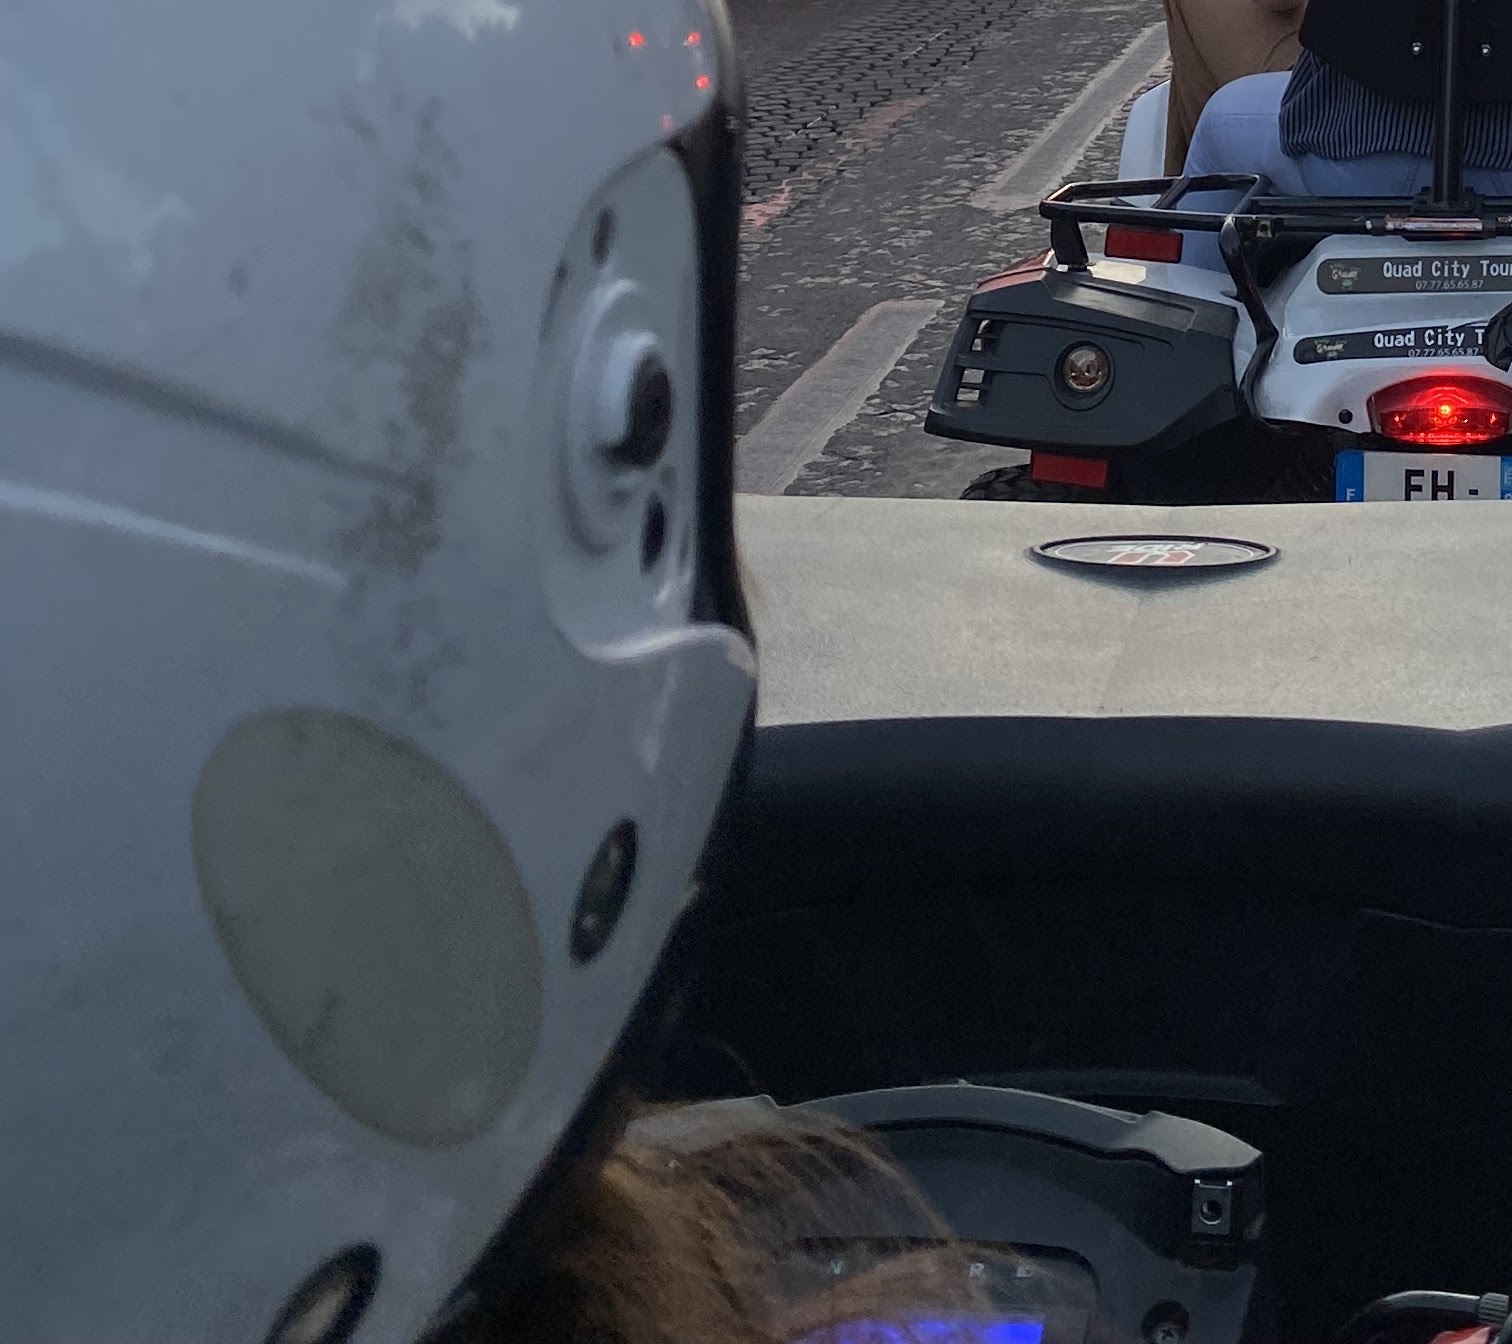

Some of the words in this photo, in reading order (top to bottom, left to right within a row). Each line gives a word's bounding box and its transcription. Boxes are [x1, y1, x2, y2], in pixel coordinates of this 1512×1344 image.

[1383, 261, 1422, 278] Quad
[1431, 260, 1470, 278] City
[1374, 330, 1415, 348] Quad
[1424, 328, 1465, 347] City
